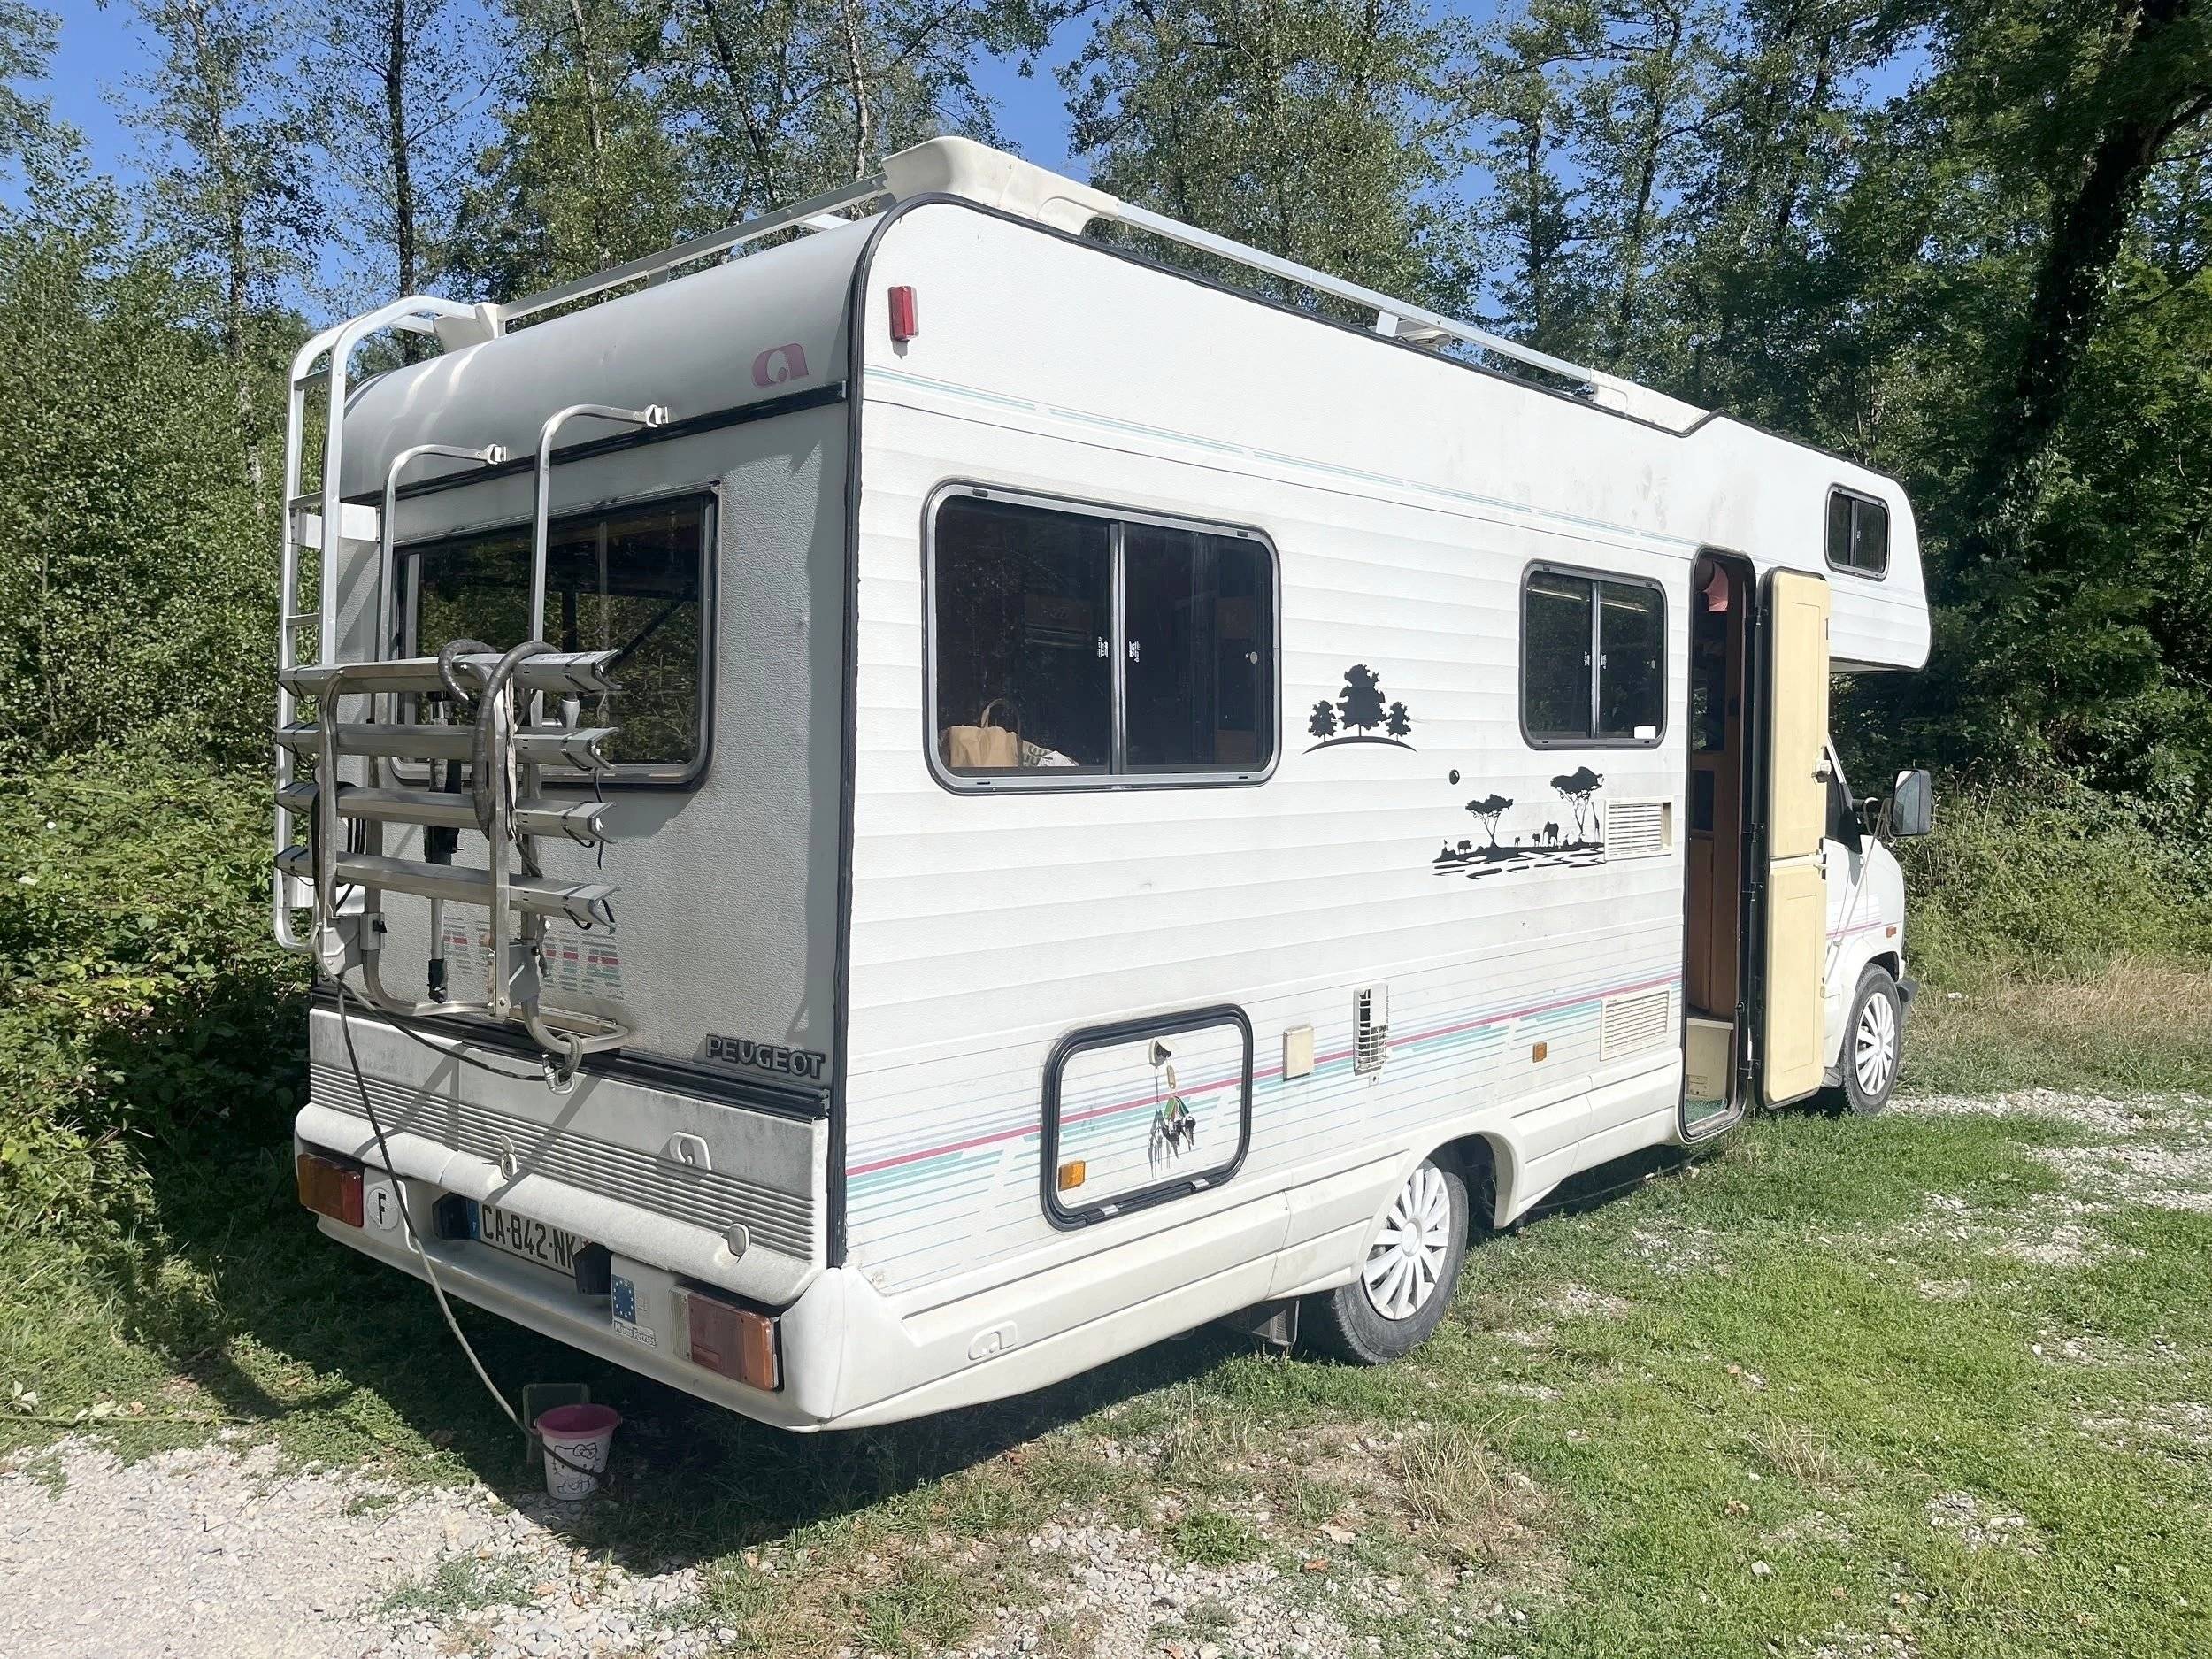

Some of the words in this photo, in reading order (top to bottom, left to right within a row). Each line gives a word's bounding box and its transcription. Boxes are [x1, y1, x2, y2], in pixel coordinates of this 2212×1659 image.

[706, 1034, 826, 1079] PEUGEOT
[378, 1192, 387, 1225] F
[482, 1204, 577, 1269] CA-842-NK
